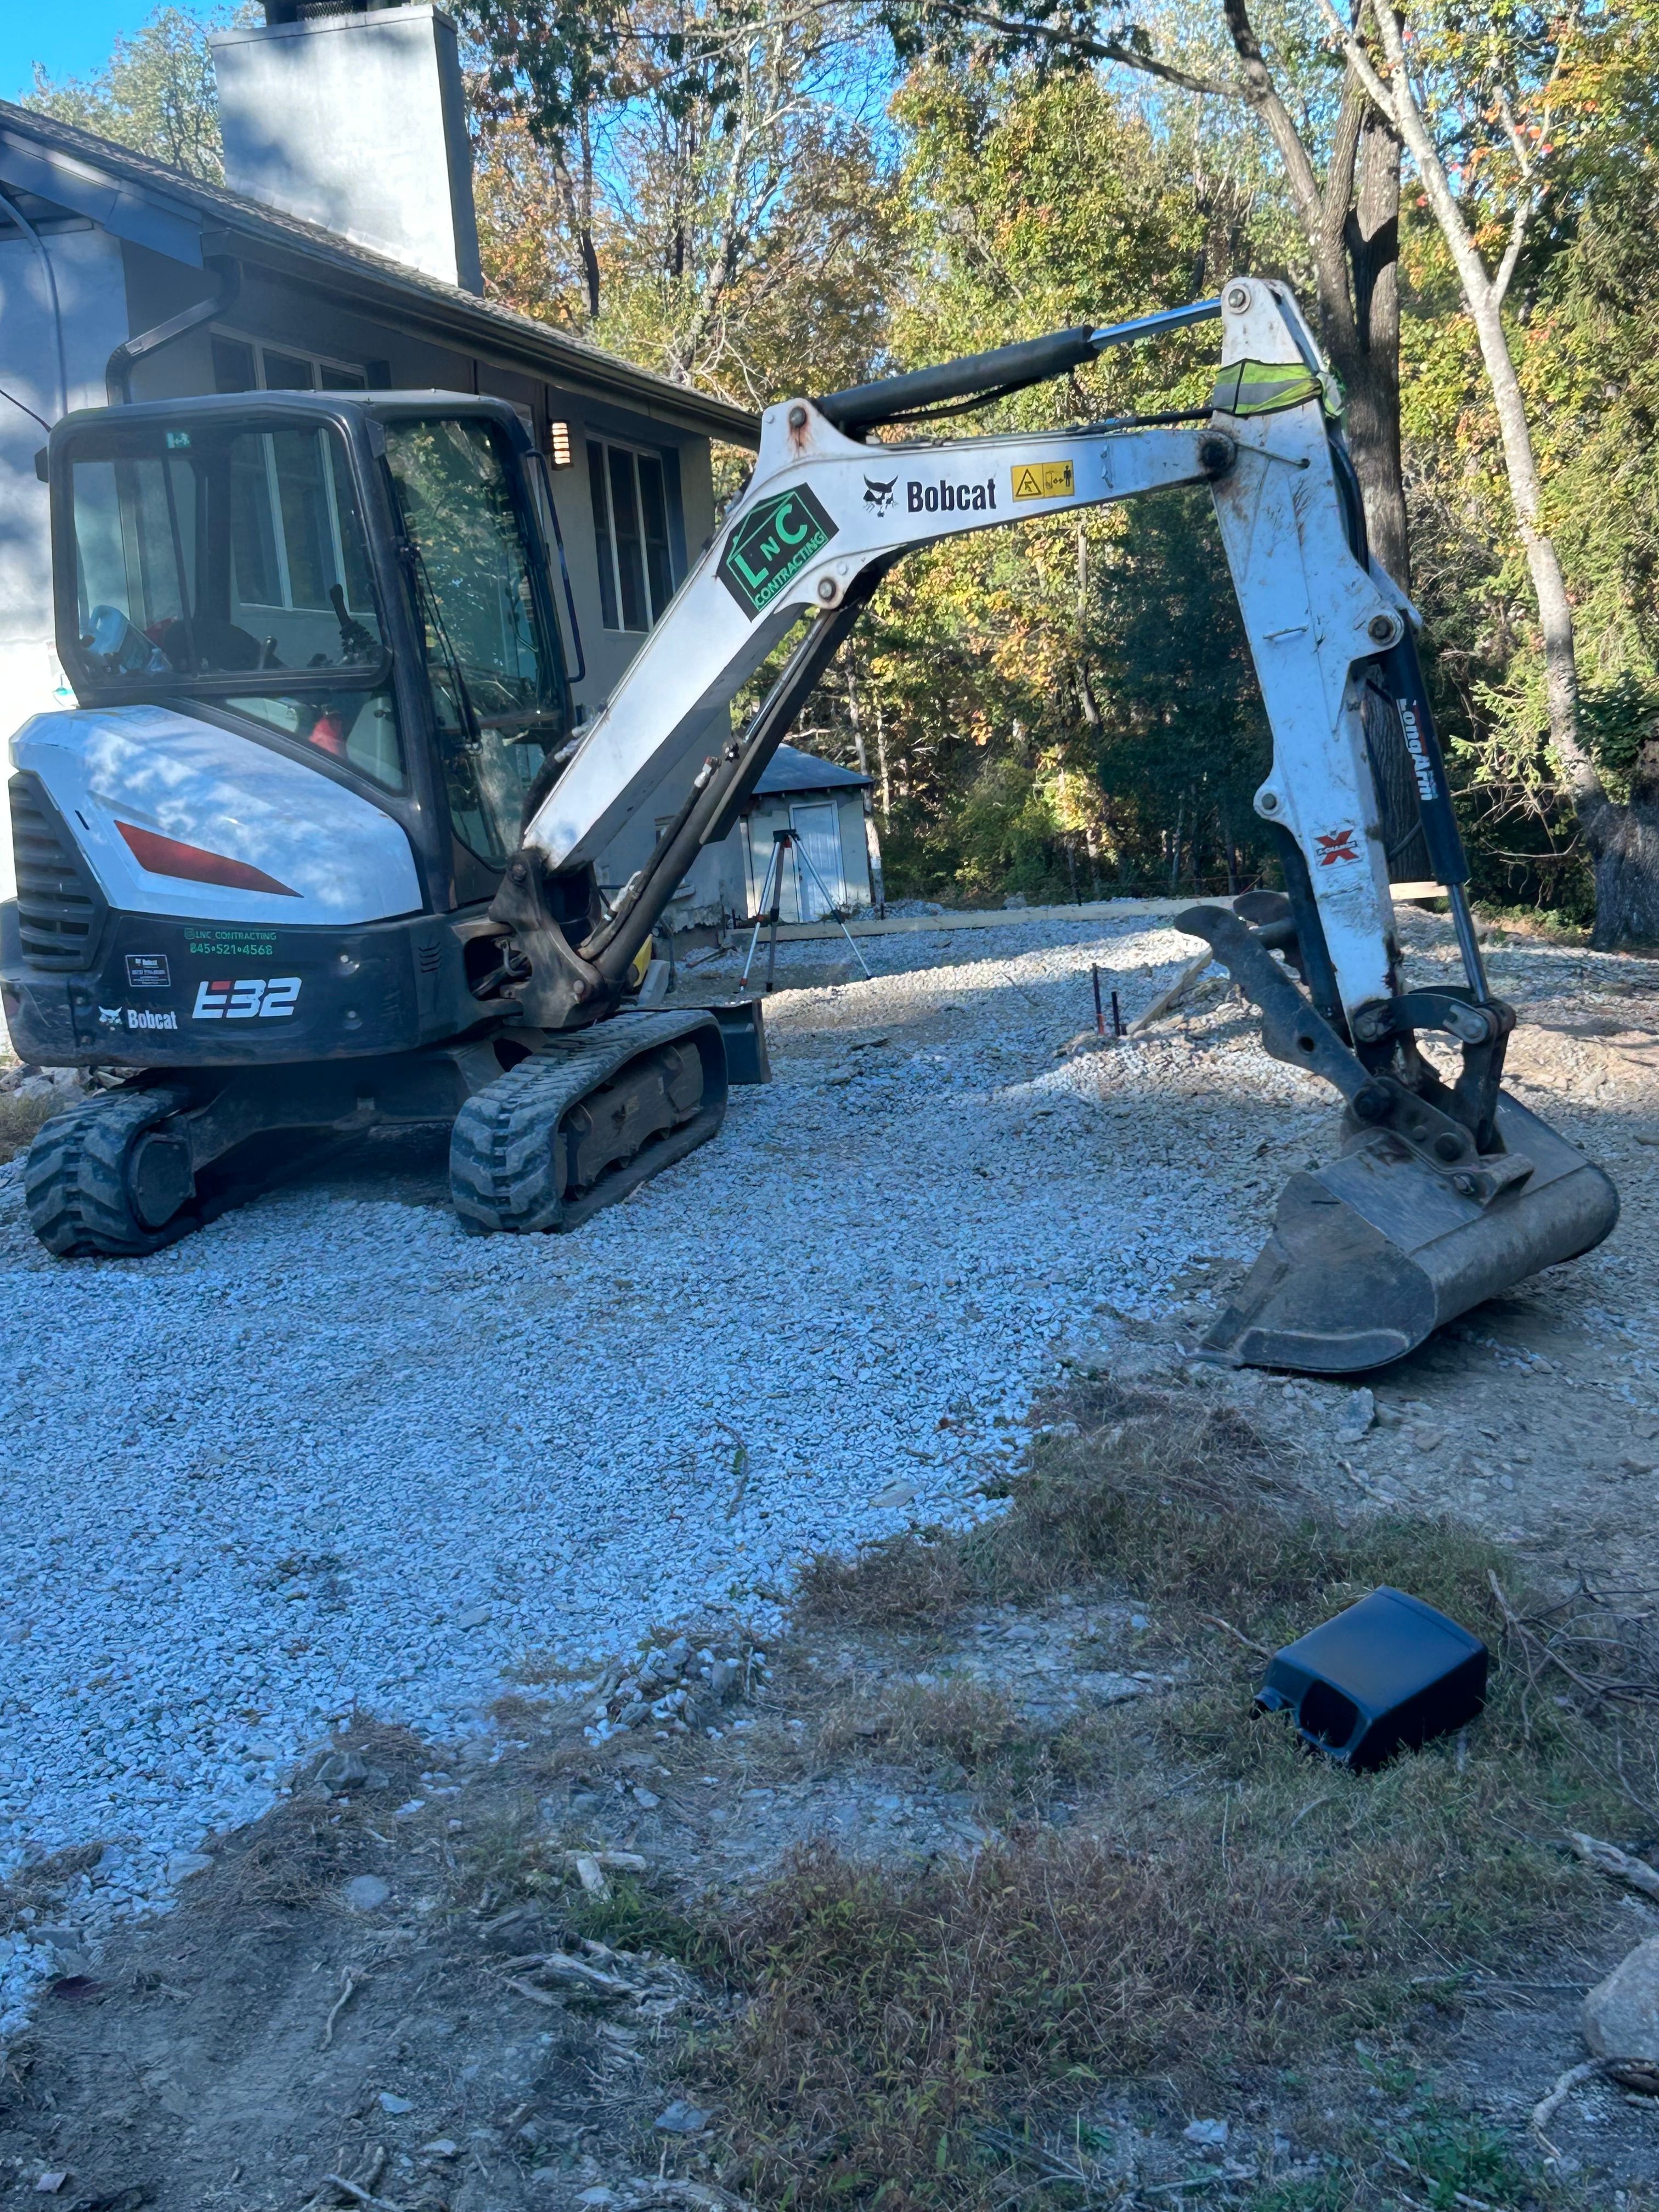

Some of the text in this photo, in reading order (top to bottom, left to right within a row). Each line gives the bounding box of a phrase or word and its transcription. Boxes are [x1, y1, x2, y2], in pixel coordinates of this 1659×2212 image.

[907, 478, 997, 513] Bobcat
[754, 530, 825, 607] CONTRACTING
[215, 932, 276, 940] CONTRACTING
[192, 977, 302, 1019] E32
[127, 1009, 178, 1030] Bobcat
